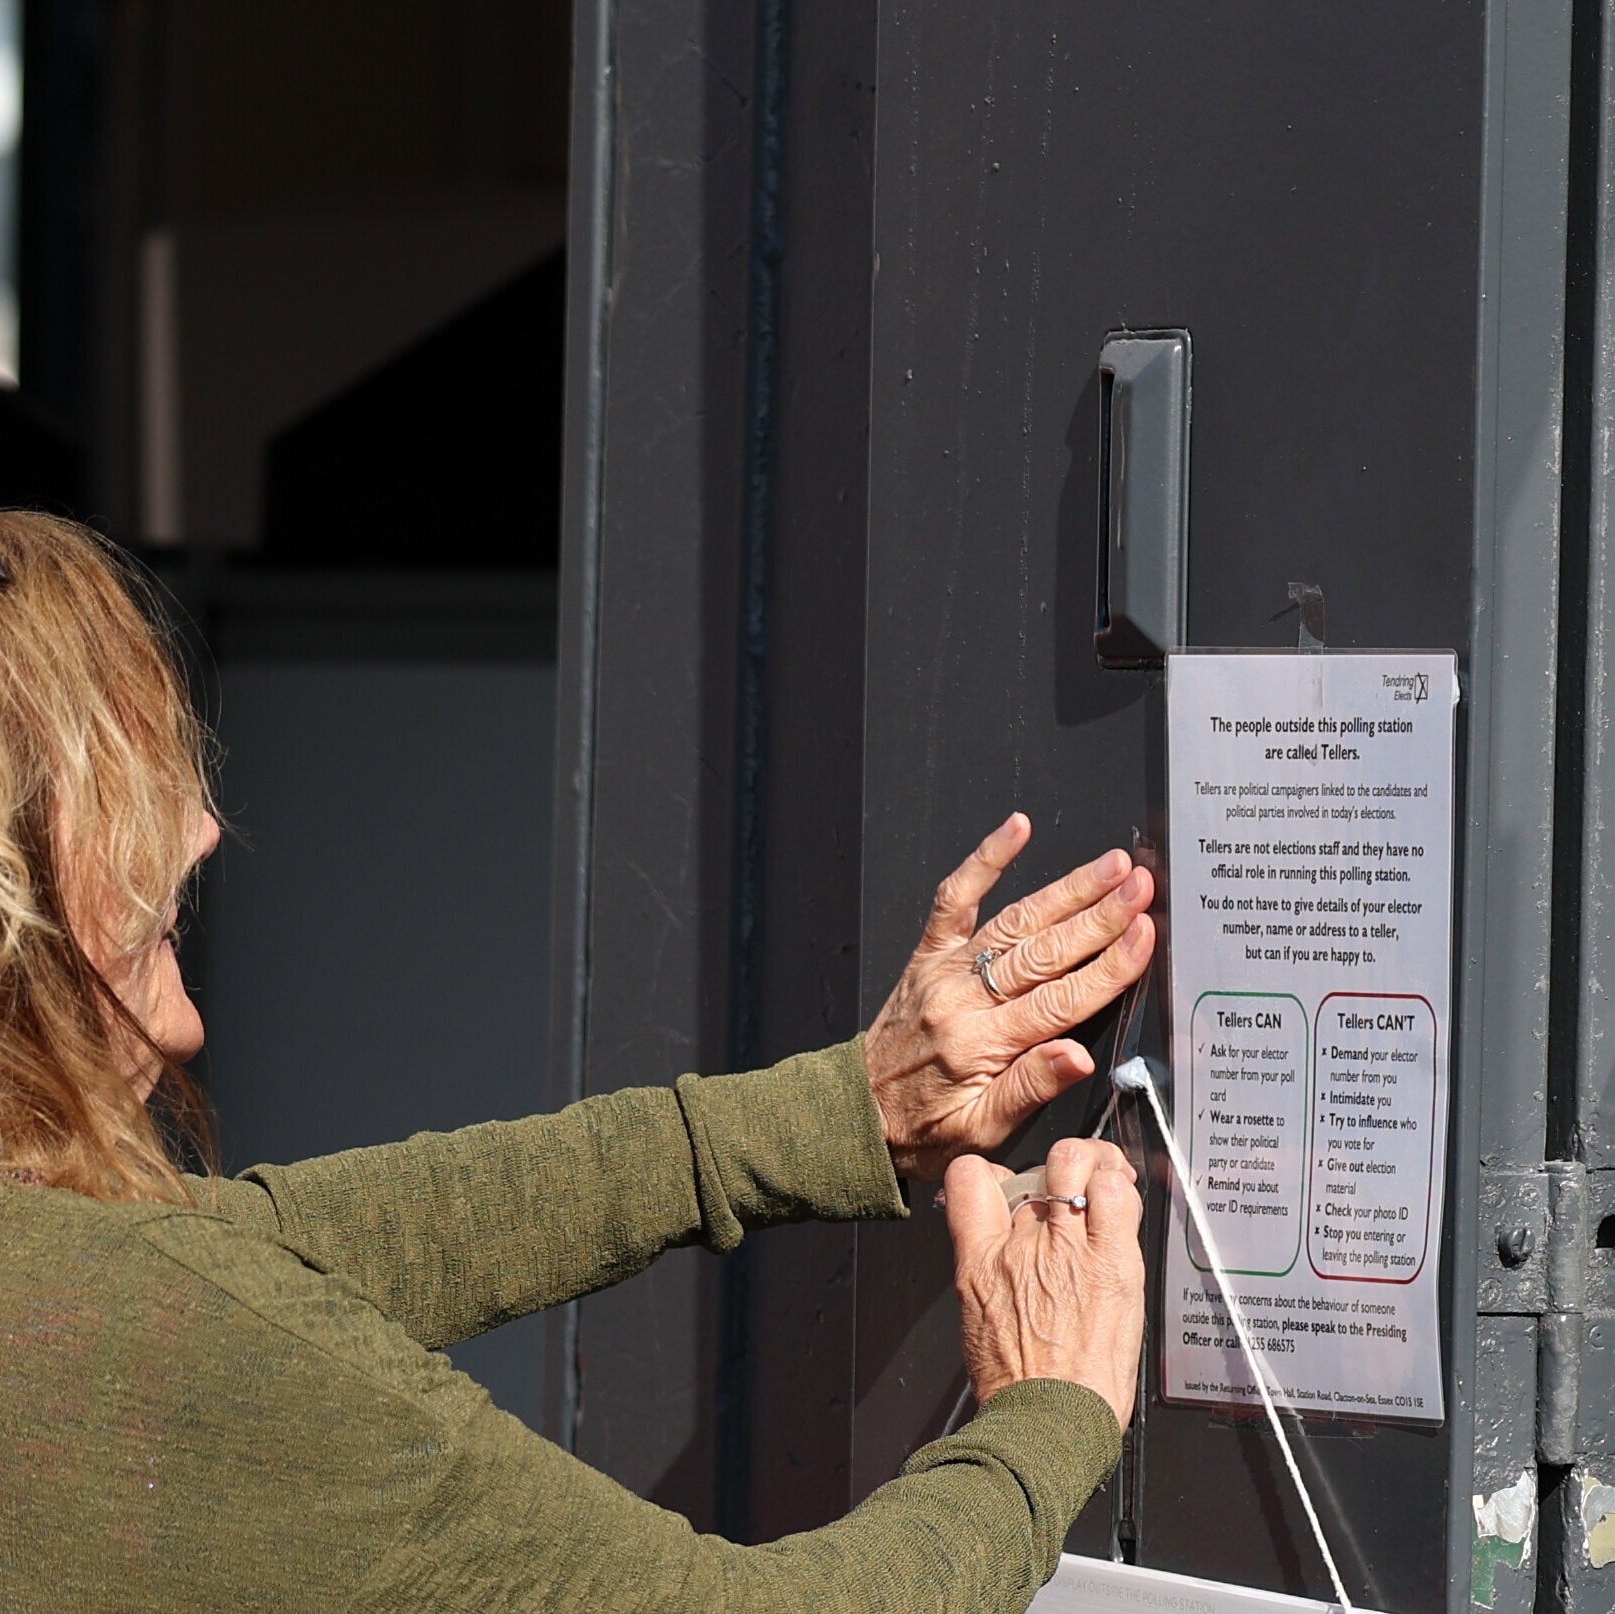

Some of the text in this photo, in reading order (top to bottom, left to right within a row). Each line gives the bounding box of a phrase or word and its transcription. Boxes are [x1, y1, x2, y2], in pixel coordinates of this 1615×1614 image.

[1382, 674, 1415, 691] Tendring
[1393, 690, 1412, 701] Elects
[1210, 716, 1412, 737] The people outside this polling station
[1264, 744, 1360, 760] are called Tellers.
[1198, 838, 1424, 860] Tellers are not elections staff and they have no
[1211, 863, 1410, 885] official role in running this polling station.
[1199, 894, 1422, 917] You do not have to give details of your elector
[1216, 1010, 1281, 1029] Tellers CAN
[1337, 1012, 1415, 1031] Tellers CAN'T
[1331, 1046, 1418, 1064] Demand your elector
[1329, 1092, 1391, 1109] Intimidate you
[1324, 1203, 1408, 1222] Check your photo ID
